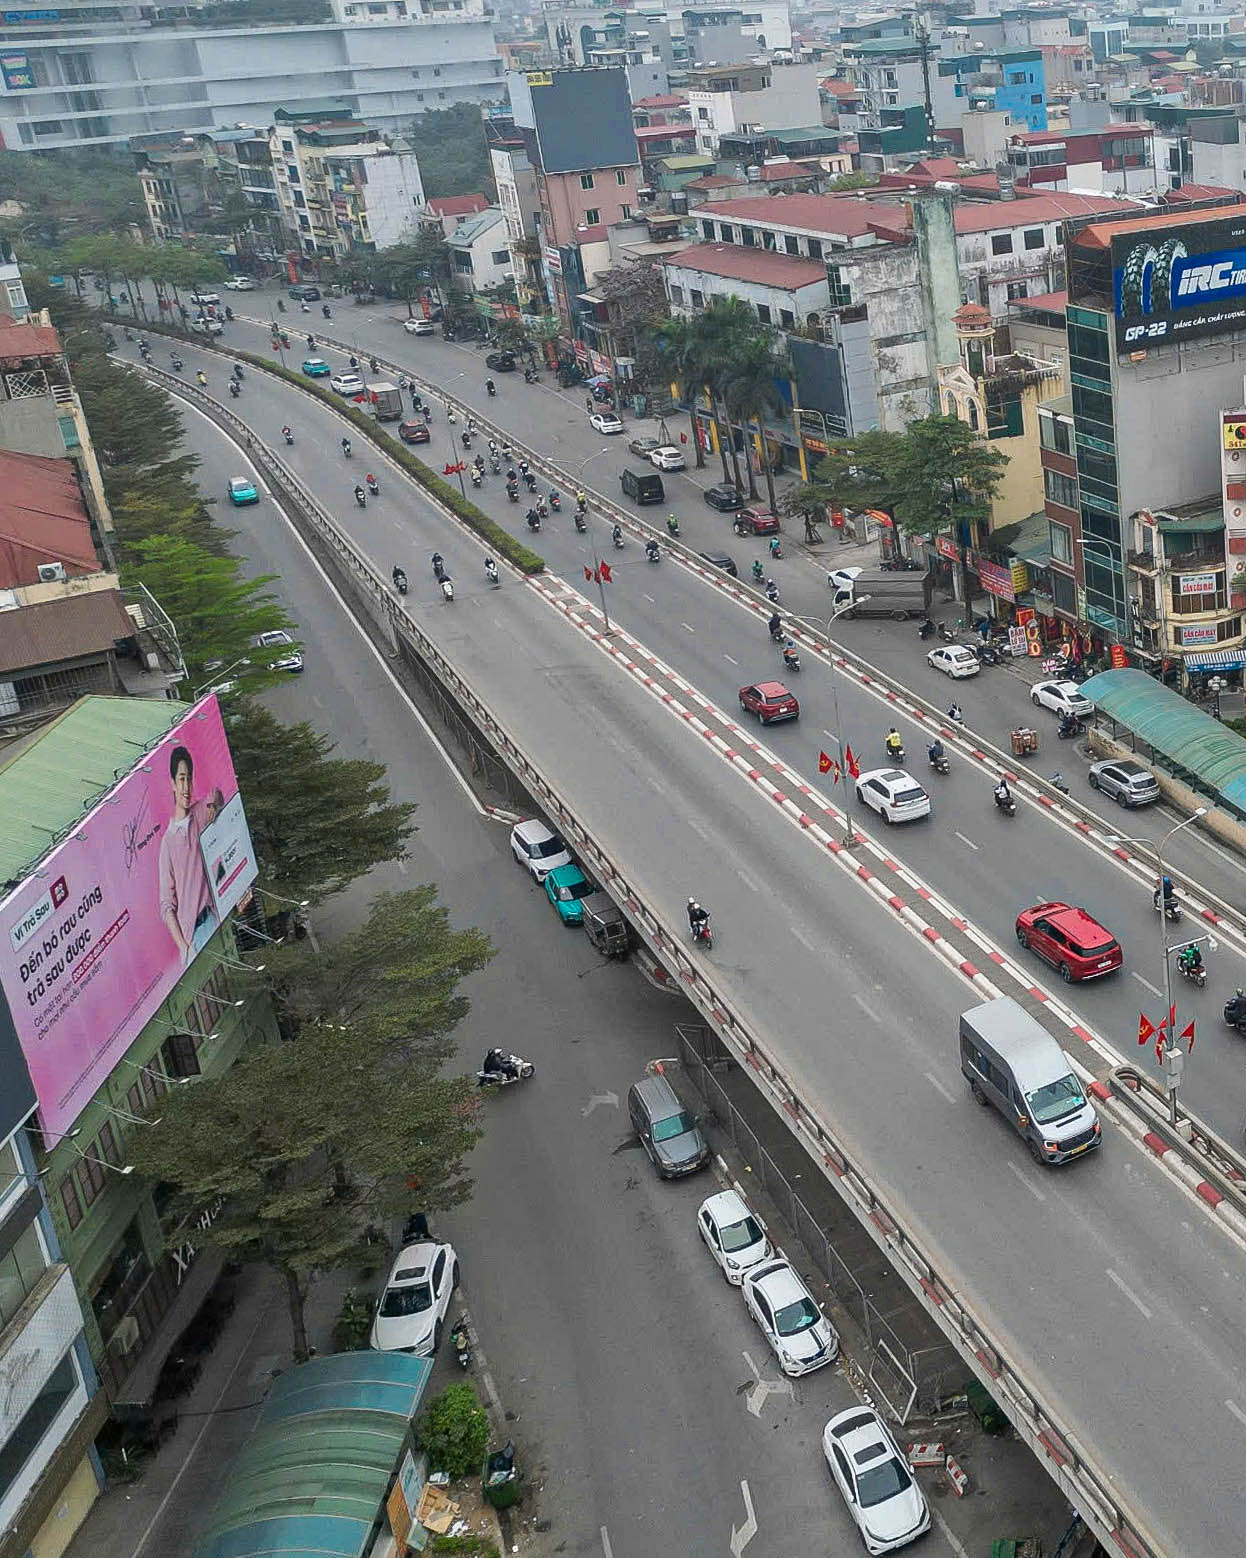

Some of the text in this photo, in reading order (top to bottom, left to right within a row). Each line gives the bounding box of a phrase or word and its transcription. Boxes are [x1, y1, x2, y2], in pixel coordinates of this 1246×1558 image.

[1125, 321, 1167, 342] GP-22
[14, 902, 50, 942] Ví Trả Sau
[19, 885, 103, 983] Đến bó rau cũng
[26, 927, 92, 1007] trả sau được
